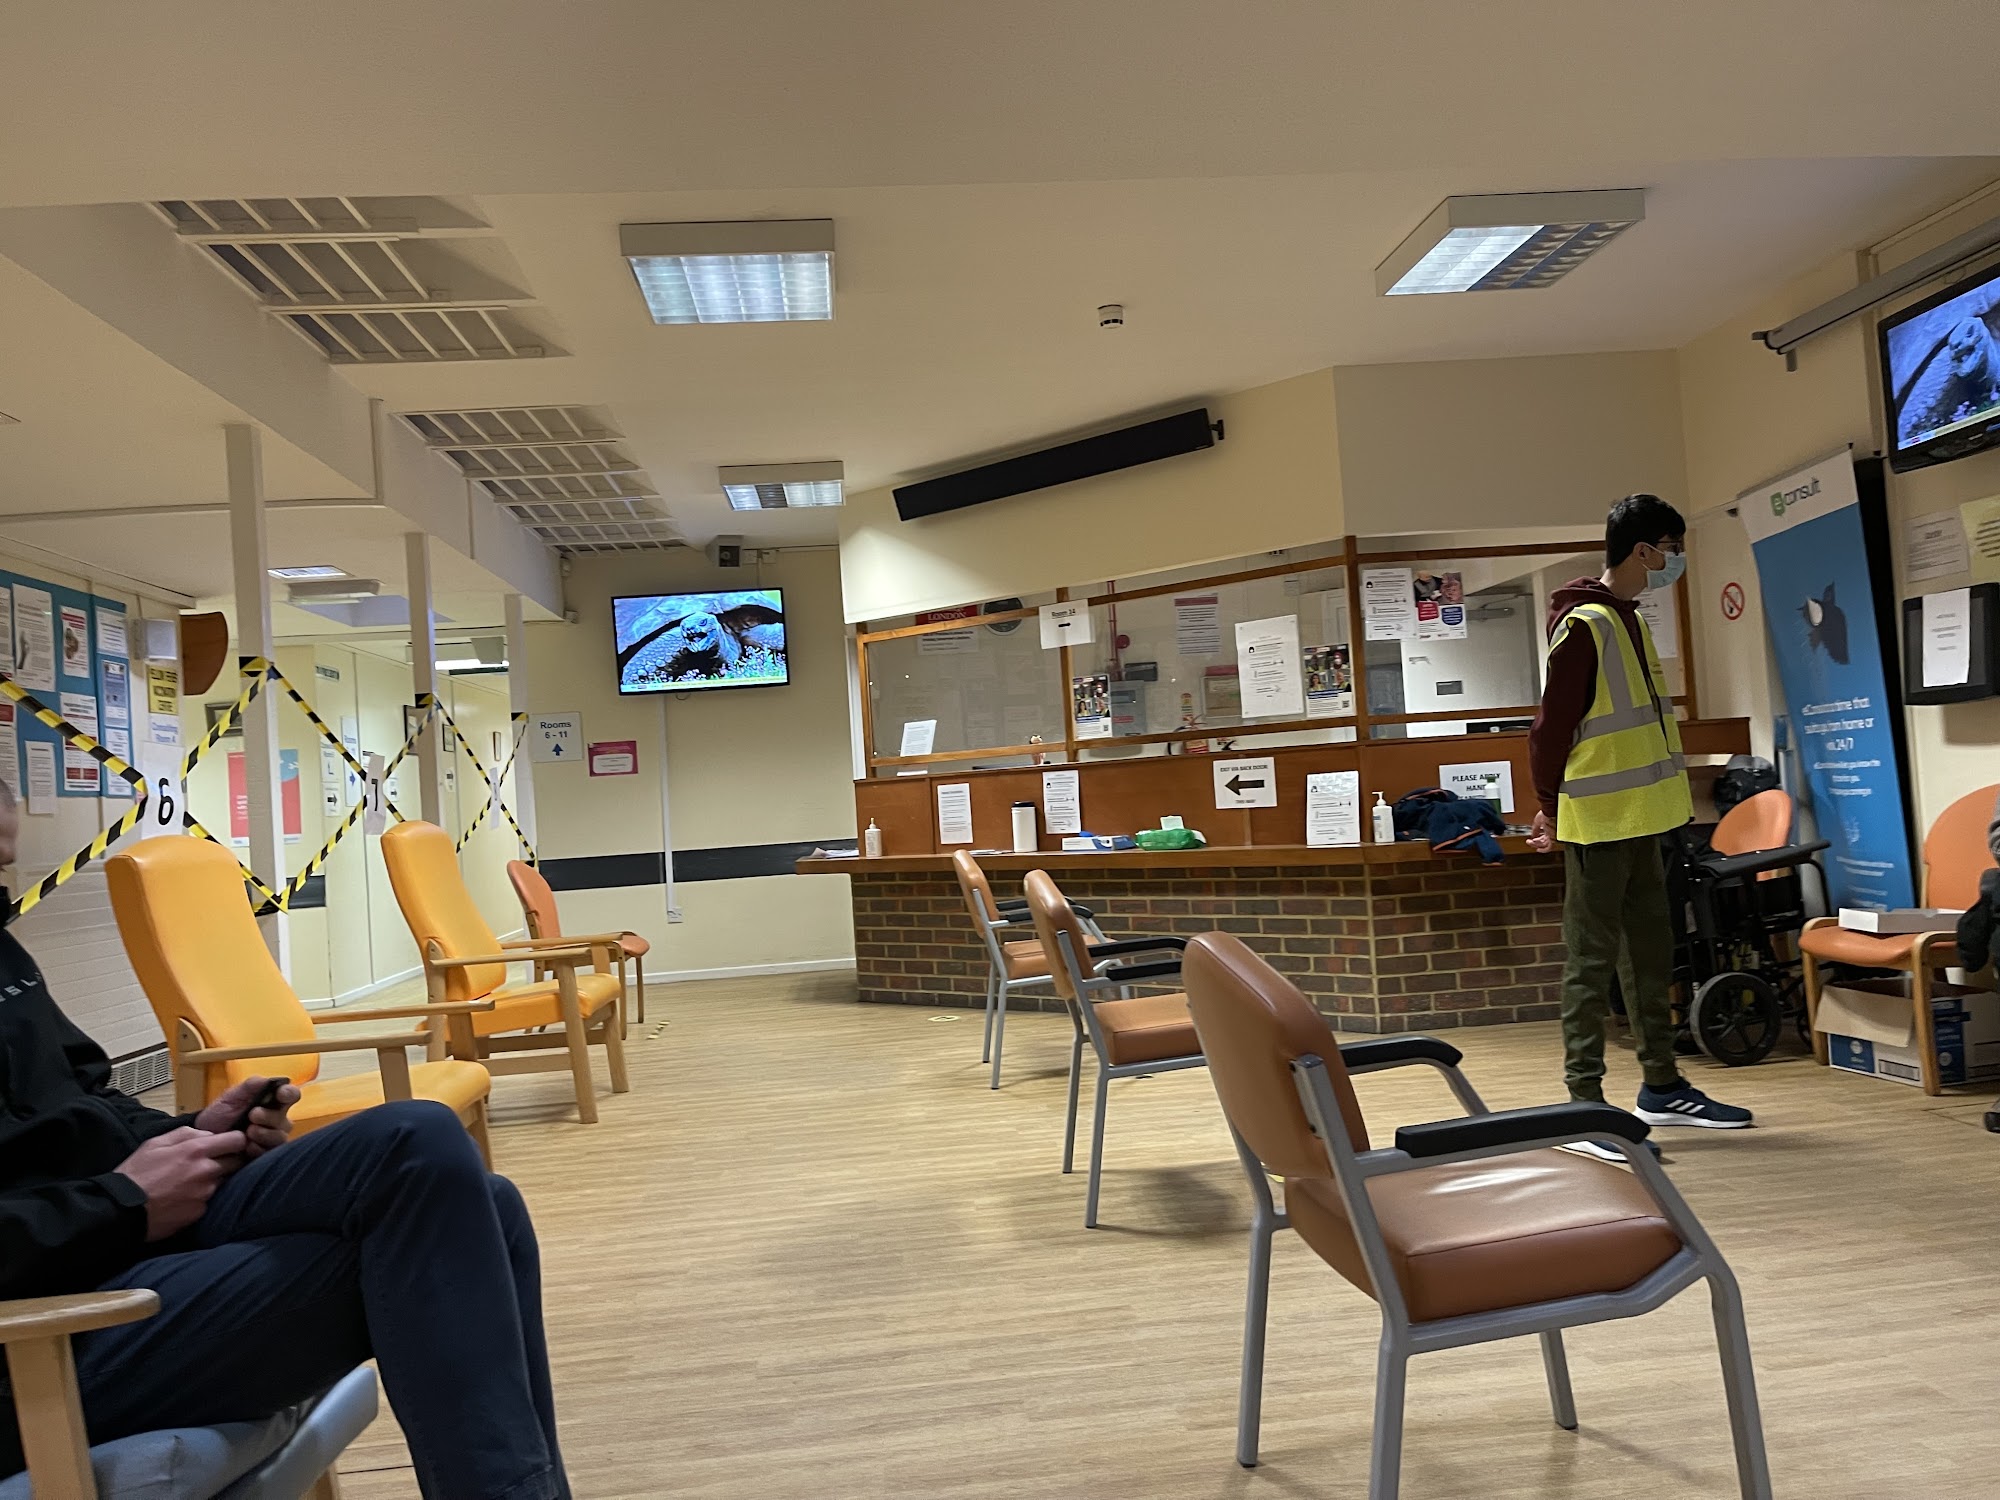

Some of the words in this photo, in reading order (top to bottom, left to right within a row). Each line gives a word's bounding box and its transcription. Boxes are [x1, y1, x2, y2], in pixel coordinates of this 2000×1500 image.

[927, 611, 967, 621] LONDON
[540, 721, 572, 729] Rooms
[544, 731, 550, 739] 6
[558, 730, 568, 738] 11
[1452, 774, 1478, 782] PLEASE
[158, 777, 174, 826] 6
